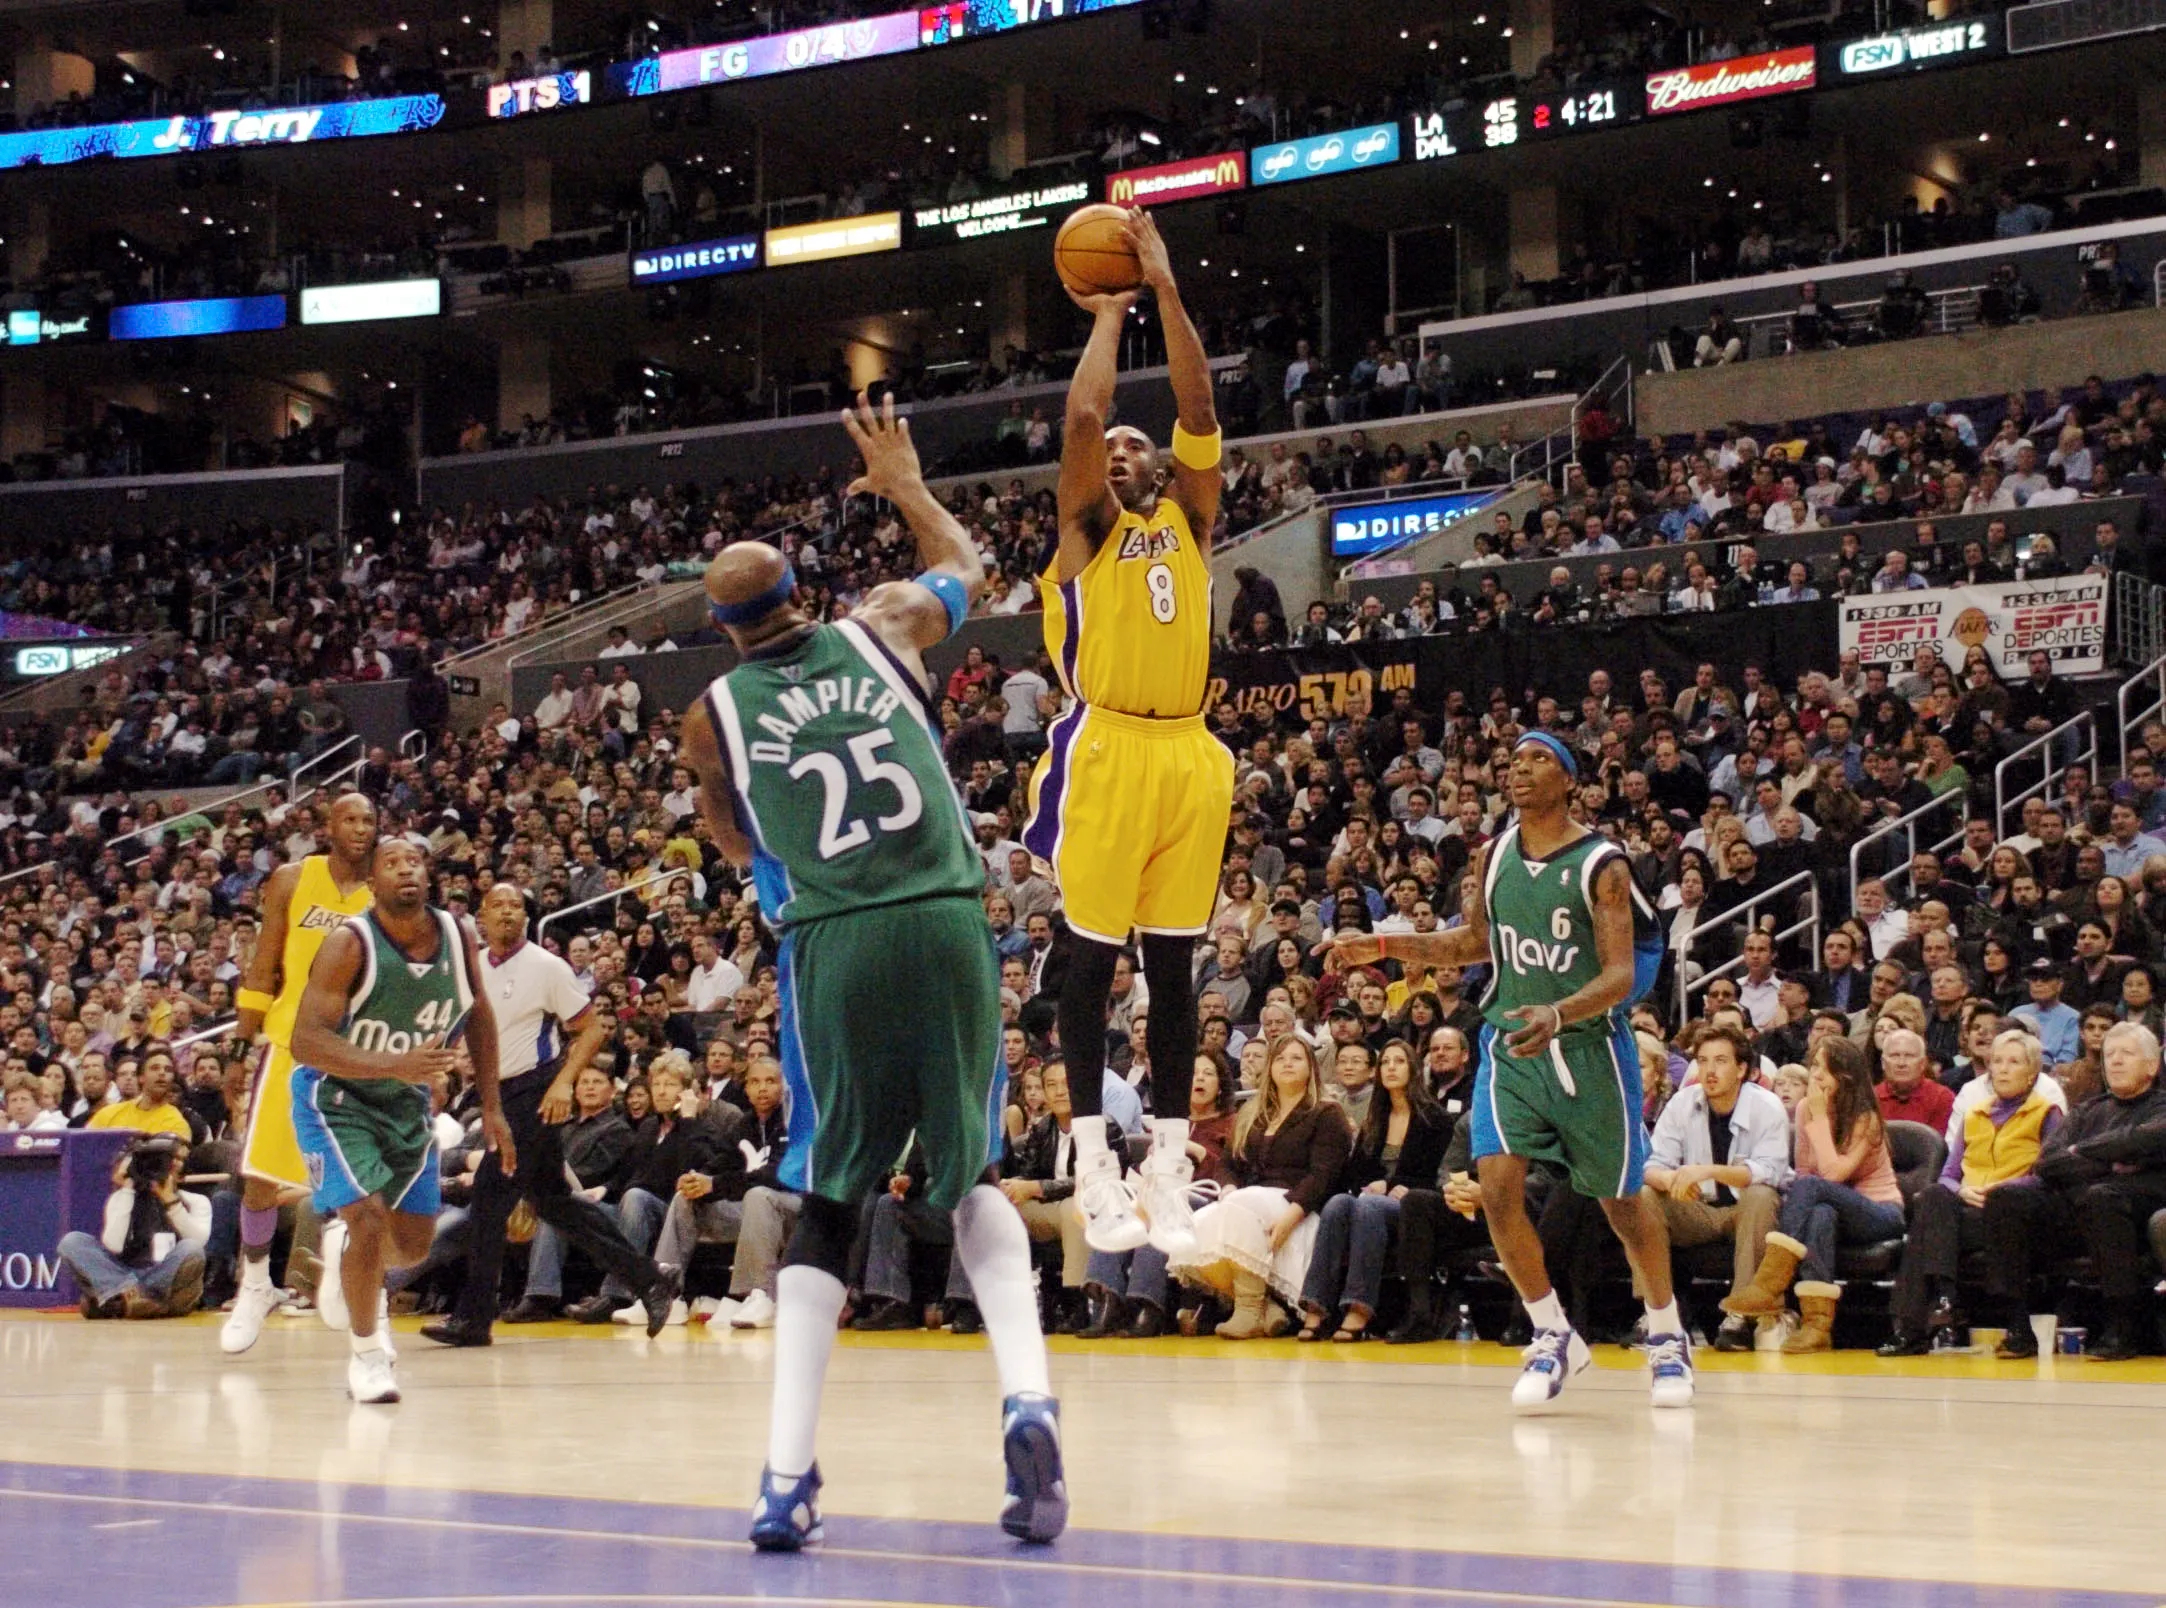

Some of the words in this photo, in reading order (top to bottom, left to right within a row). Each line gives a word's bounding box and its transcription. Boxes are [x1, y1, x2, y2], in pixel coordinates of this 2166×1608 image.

[921, 2, 970, 43] FT
[700, 45, 749, 82] FG
[786, 28, 847, 67] 0/4
[1852, 42, 1894, 67] FSN
[1908, 26, 1966, 59] WEST
[1968, 22, 1987, 49] 2
[489, 78, 560, 117] PTS
[573, 70, 590, 103] 1
[1646, 59, 1814, 110] Budweiser
[153, 116, 192, 148] J.
[211, 110, 321, 144] Terry
[1415, 113, 1444, 138] LA
[1484, 98, 1517, 124] 45
[1534, 104, 1550, 128] 2
[1561, 91, 1615, 126] 4:21
[1415, 134, 1457, 160] DAL
[1484, 122, 1518, 147] 38
[915, 209, 942, 227] THE
[942, 203, 970, 223] LOS
[970, 191, 1033, 218] ANGELES
[1033, 182, 1089, 207] LAKERS
[660, 243, 757, 271] DIRECTV
[1115, 525, 1180, 561] LAERS
[1146, 564, 1177, 623] 8
[1851, 606, 1901, 621] 1330
[1907, 602, 1938, 616] AM
[2006, 591, 2059, 608] 1330
[2064, 586, 2099, 601] AM
[1858, 617, 1938, 644] ESPN
[2014, 602, 2098, 630] ESPN
[2003, 625, 2104, 649] DEPORTES
[2005, 645, 2101, 665] RDIO
[27, 653, 61, 669] FSN
[1381, 664, 1416, 692] AM
[751, 677, 902, 764] DAMPIER
[789, 727, 923, 860] 25
[1551, 907, 1571, 940] 6
[415, 998, 453, 1030] 44
